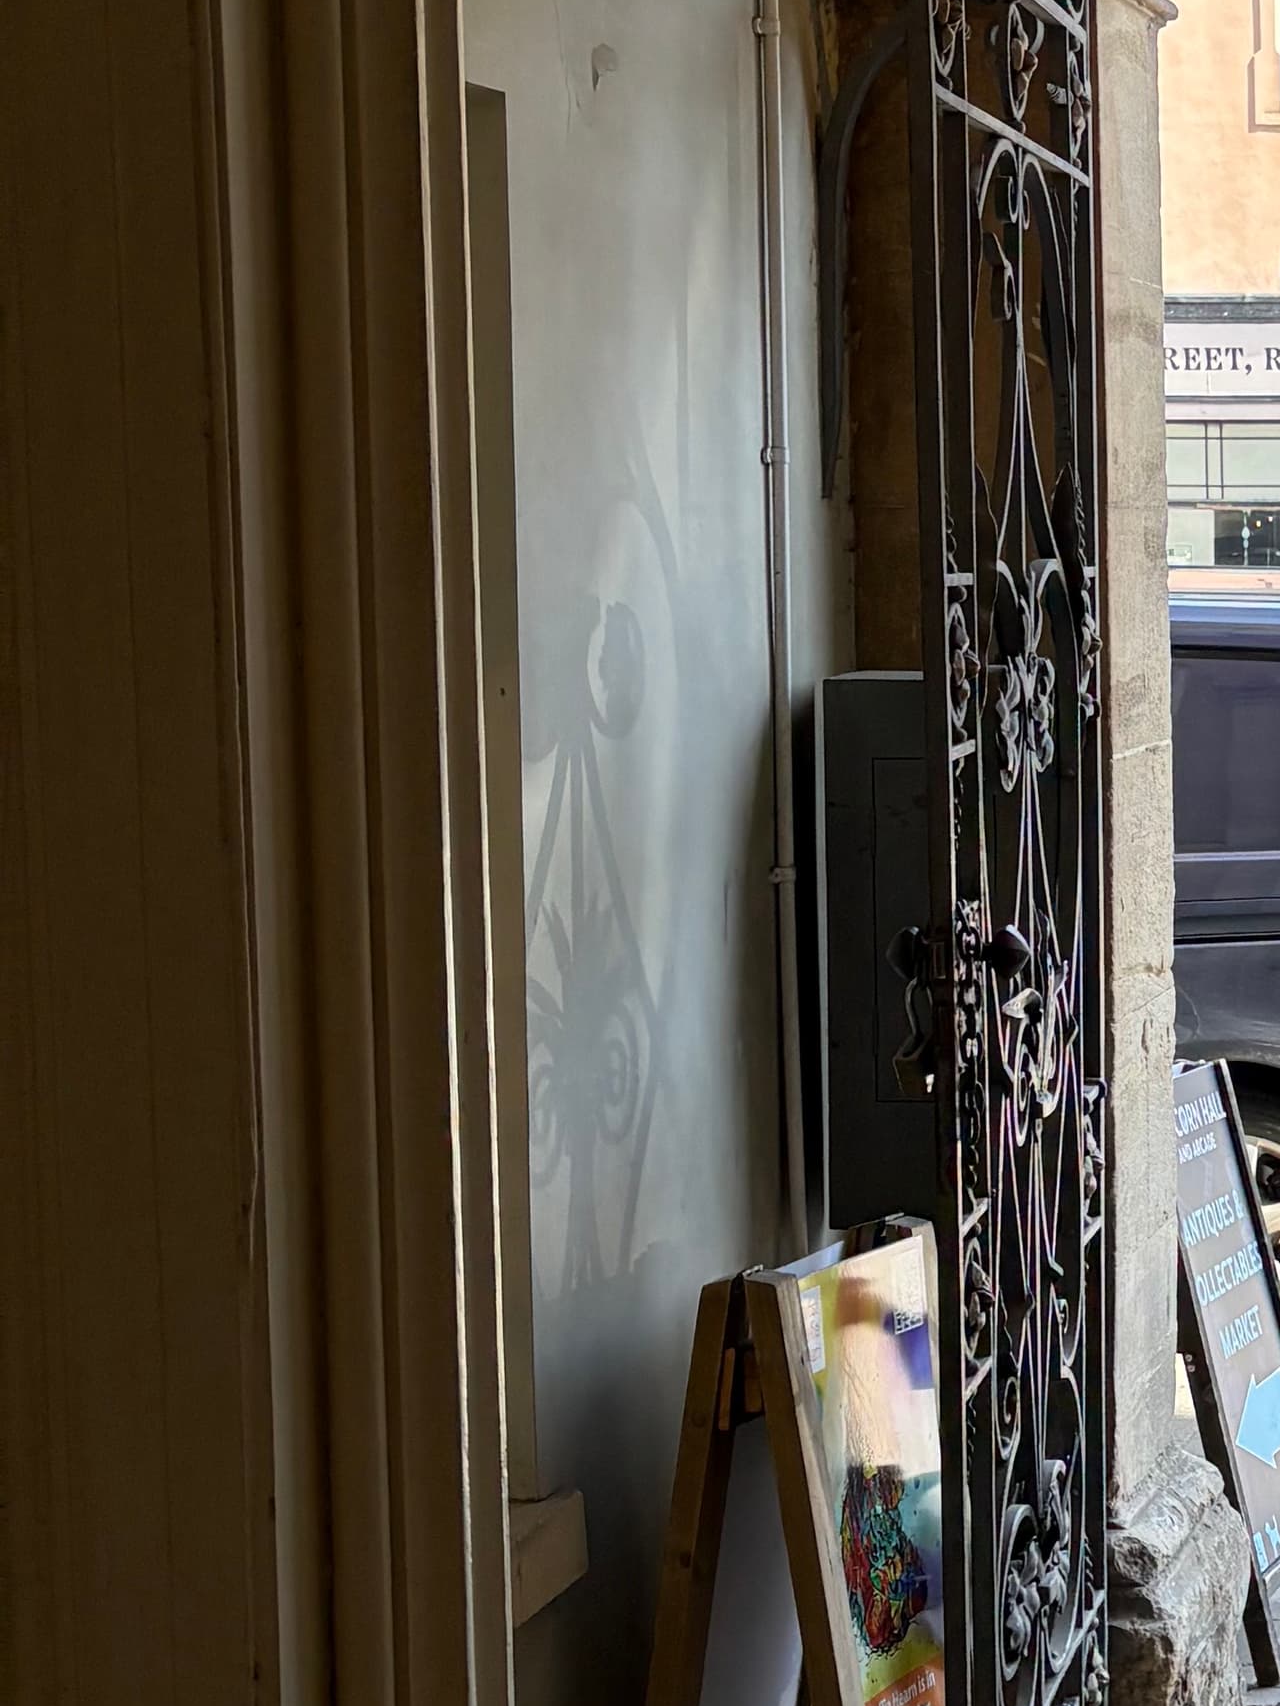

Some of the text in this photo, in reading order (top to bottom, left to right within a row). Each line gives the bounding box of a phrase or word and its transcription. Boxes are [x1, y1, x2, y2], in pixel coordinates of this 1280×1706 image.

[1199, 1091, 1227, 1126] HALL
[1182, 1189, 1245, 1248] ANTIQUES &
[1195, 1240, 1264, 1307] OLLECTABLES
[1218, 1304, 1264, 1360] MARKET
[917, 1674, 926, 1693] is
[925, 1669, 937, 1690] in
